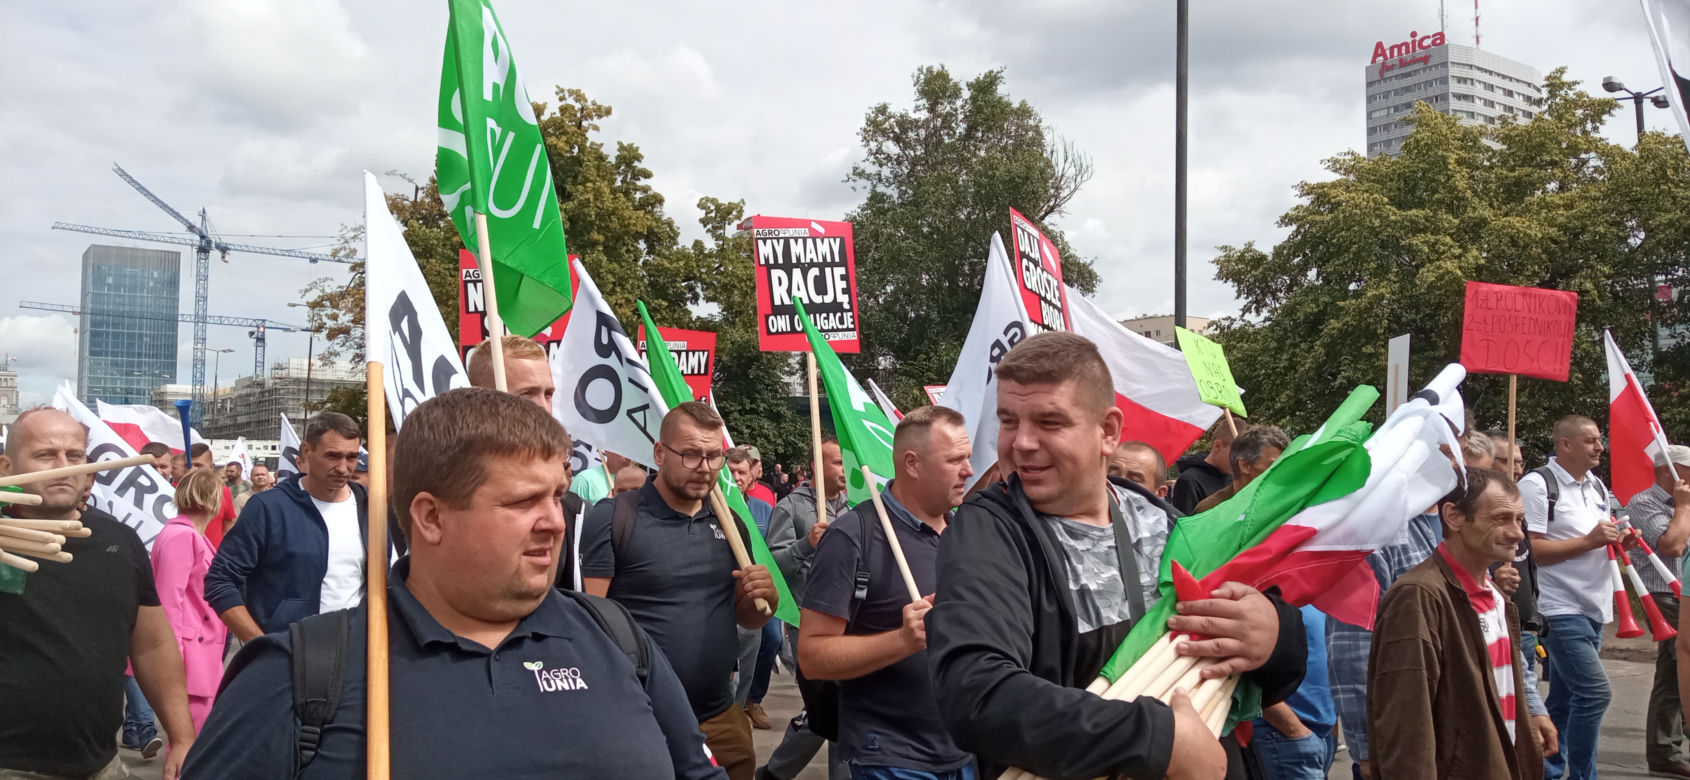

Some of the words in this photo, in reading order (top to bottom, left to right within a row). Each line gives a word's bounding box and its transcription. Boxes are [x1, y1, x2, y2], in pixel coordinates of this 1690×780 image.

[1371, 31, 1445, 64] Amica
[757, 238, 785, 265] MY
[789, 238, 840, 264] MAMY
[770, 267, 850, 309] RACJĘ
[1022, 258, 1062, 309] GROSZE
[768, 315, 791, 333] ONI
[794, 312, 855, 331] OLIGACJE
[541, 667, 581, 680] AGRO
[542, 677, 589, 692] UNIA
